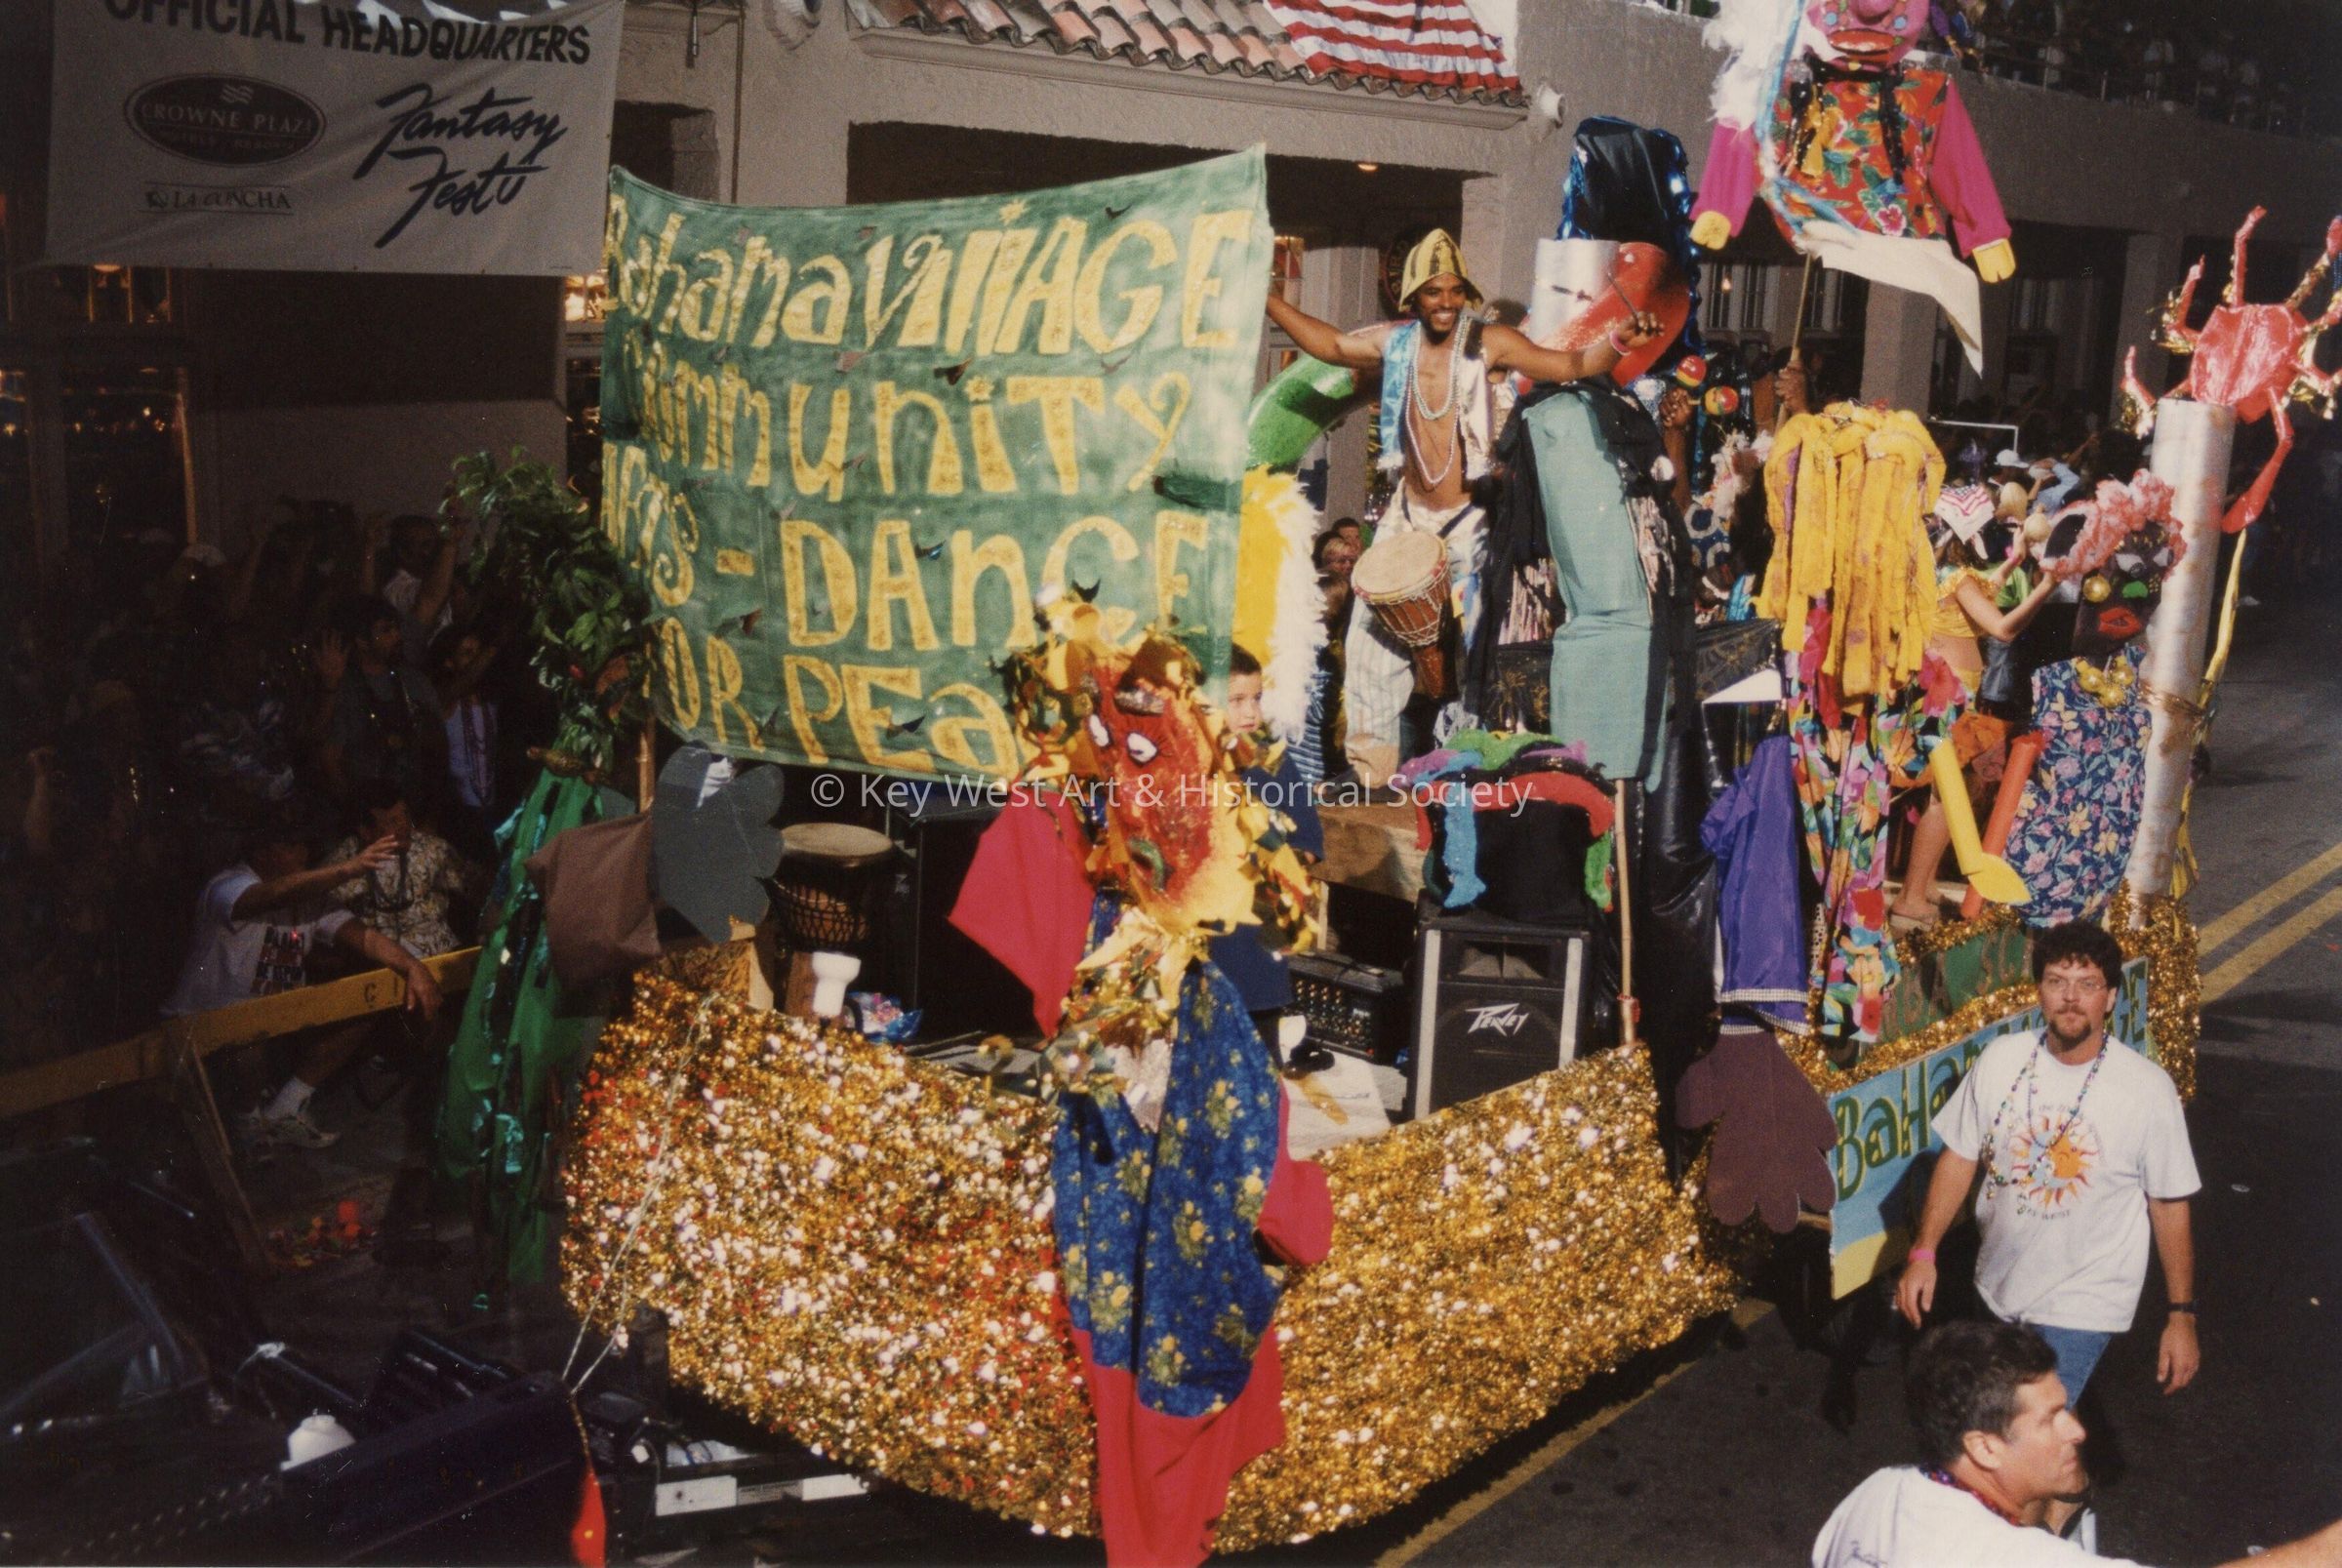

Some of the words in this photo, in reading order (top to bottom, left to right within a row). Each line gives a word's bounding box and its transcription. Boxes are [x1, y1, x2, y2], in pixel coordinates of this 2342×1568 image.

[321, 7, 591, 64] HEADQUARTERS
[141, 102, 242, 128] CROWNE
[351, 83, 569, 181] Fantasy
[375, 146, 548, 250] Fest
[1465, 1002, 1529, 1037] PEAVEY
